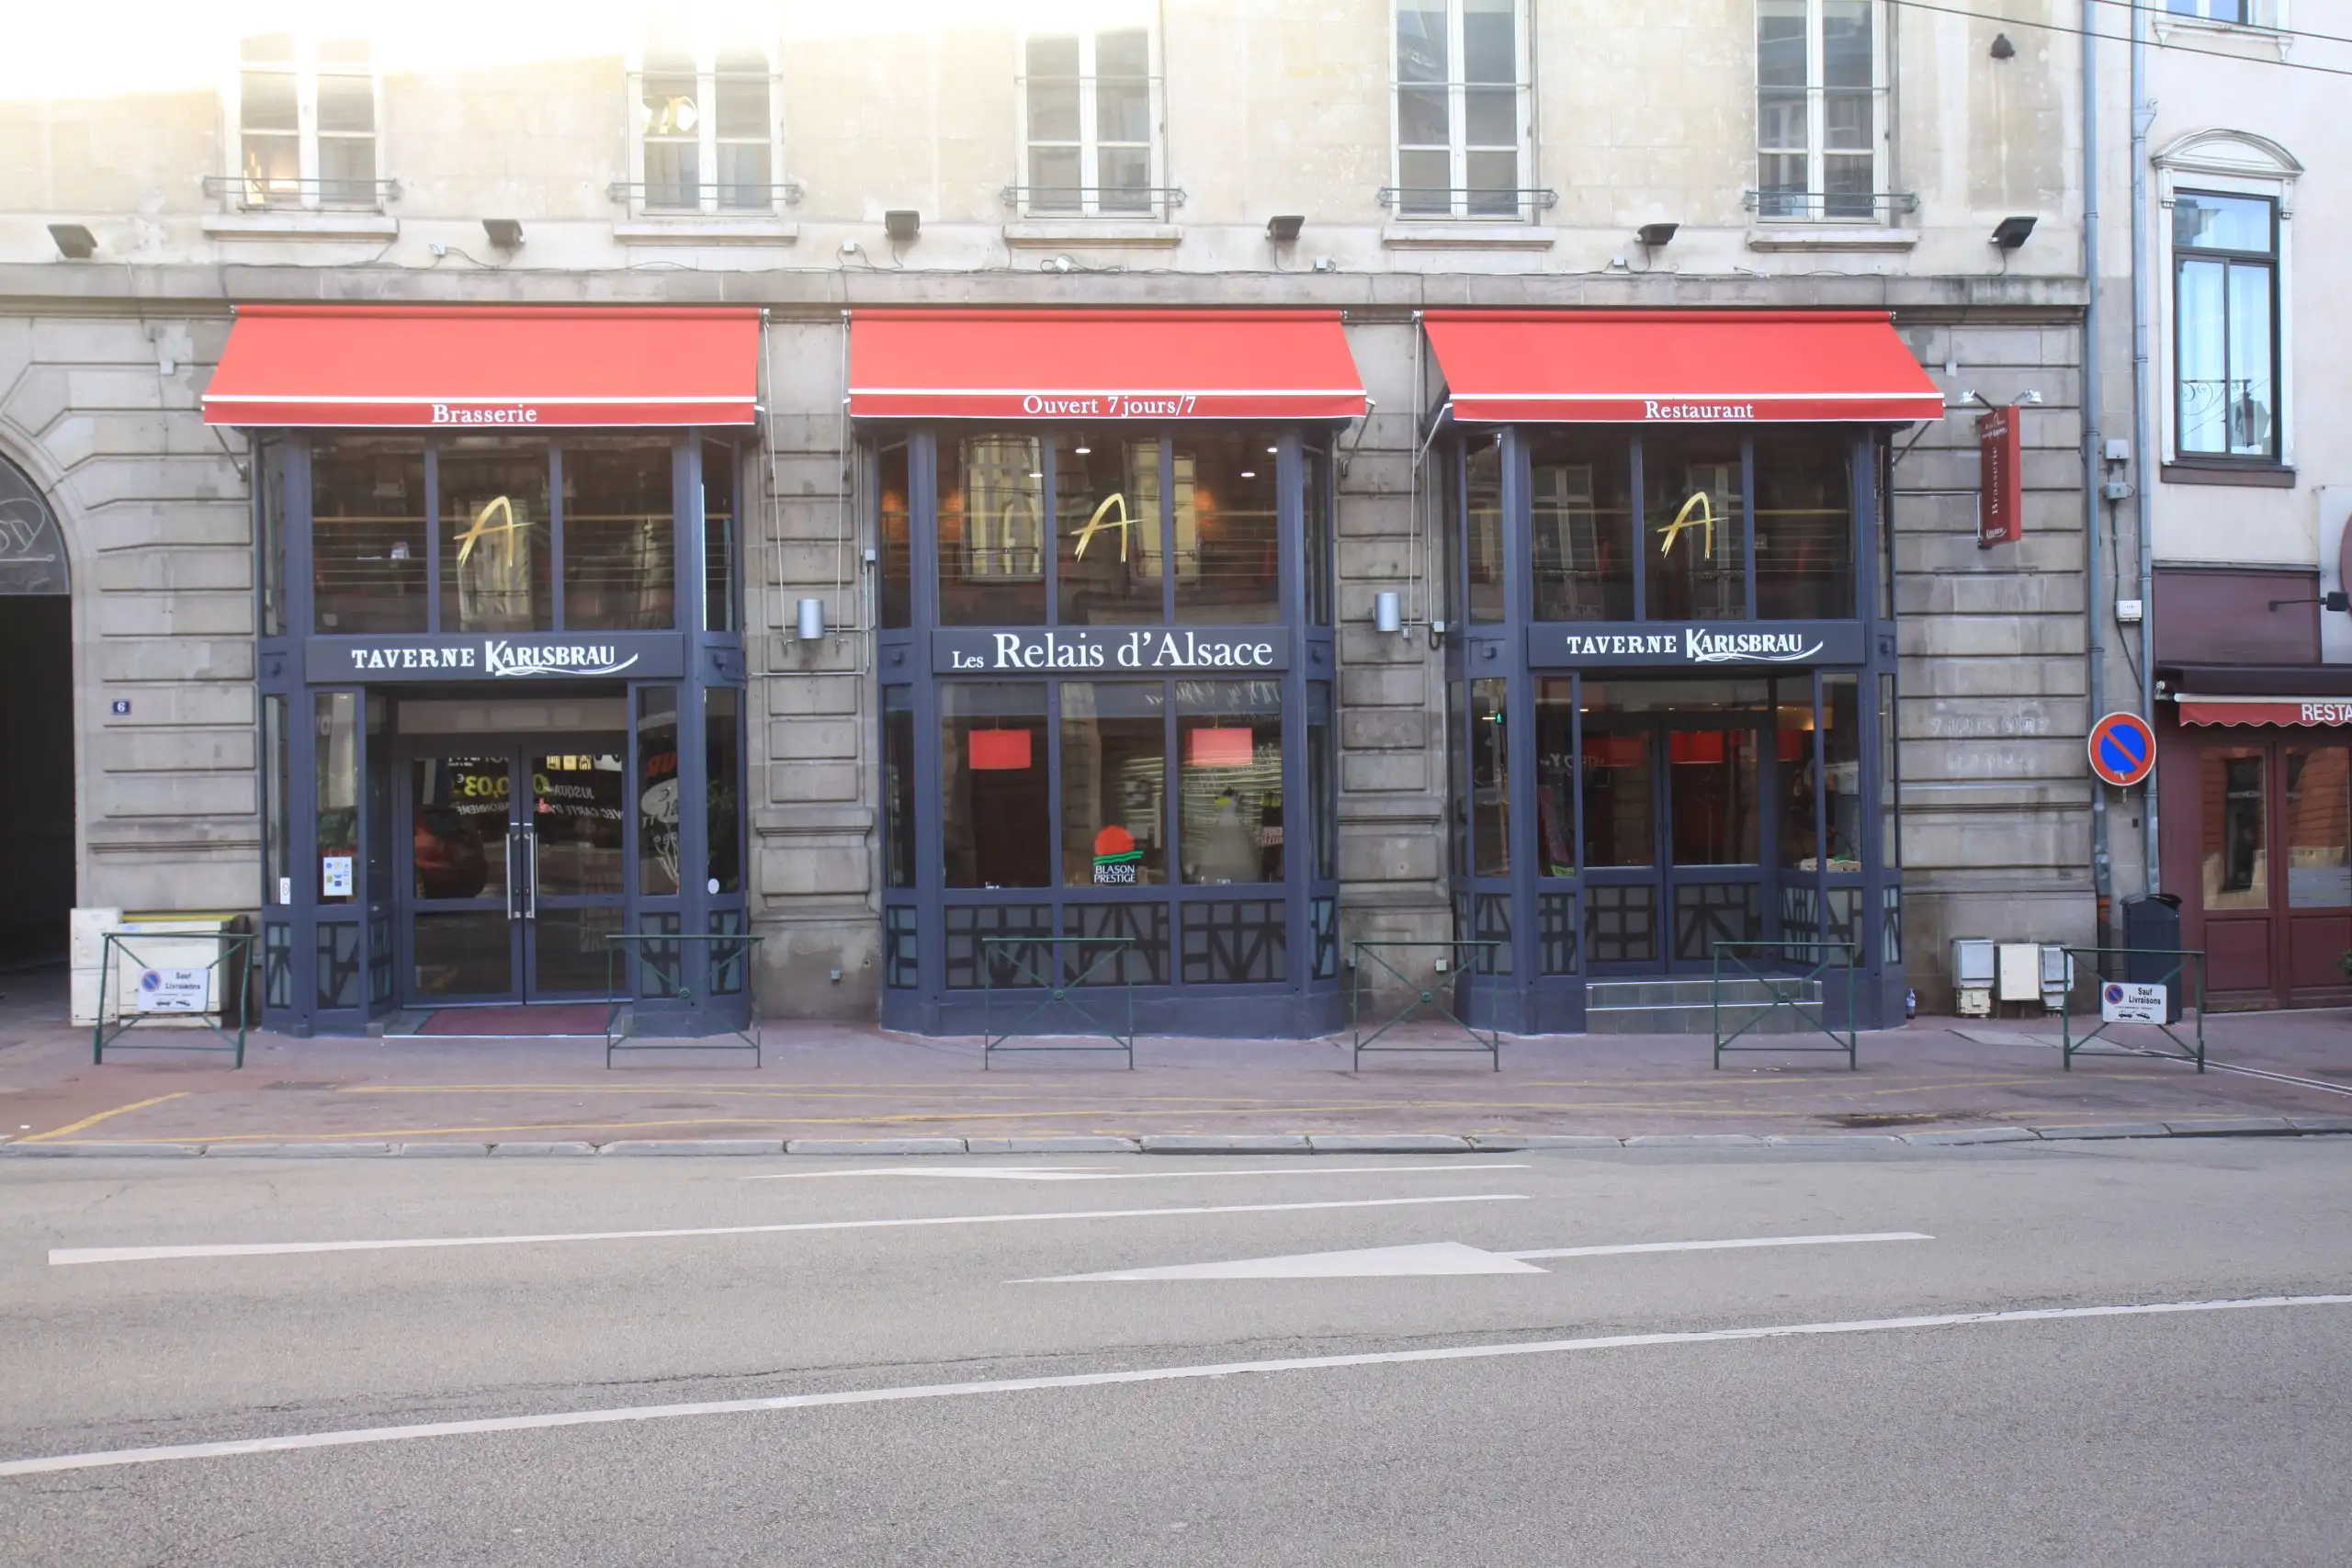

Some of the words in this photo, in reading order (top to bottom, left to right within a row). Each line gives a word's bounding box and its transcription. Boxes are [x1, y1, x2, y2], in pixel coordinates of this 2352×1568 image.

[431, 403, 537, 423] Brasserie
[1023, 395, 1099, 413] Ouvert
[1644, 400, 1755, 419] Restaurant
[1990, 446, 2000, 515] Brasserie
[952, 650, 984, 668] Les
[992, 632, 1104, 669] Relais
[1116, 631, 1273, 668] d'Alsace
[1566, 635, 1678, 655] TAVERNE
[351, 648, 475, 669] TAVERNE
[117, 701, 126, 712] 6
[1095, 864, 1136, 874] BLASON
[1093, 874, 1136, 884] PRESTIGE
[2129, 996, 2161, 1005] Livraisons
[2138, 987, 2153, 996] Sauf
